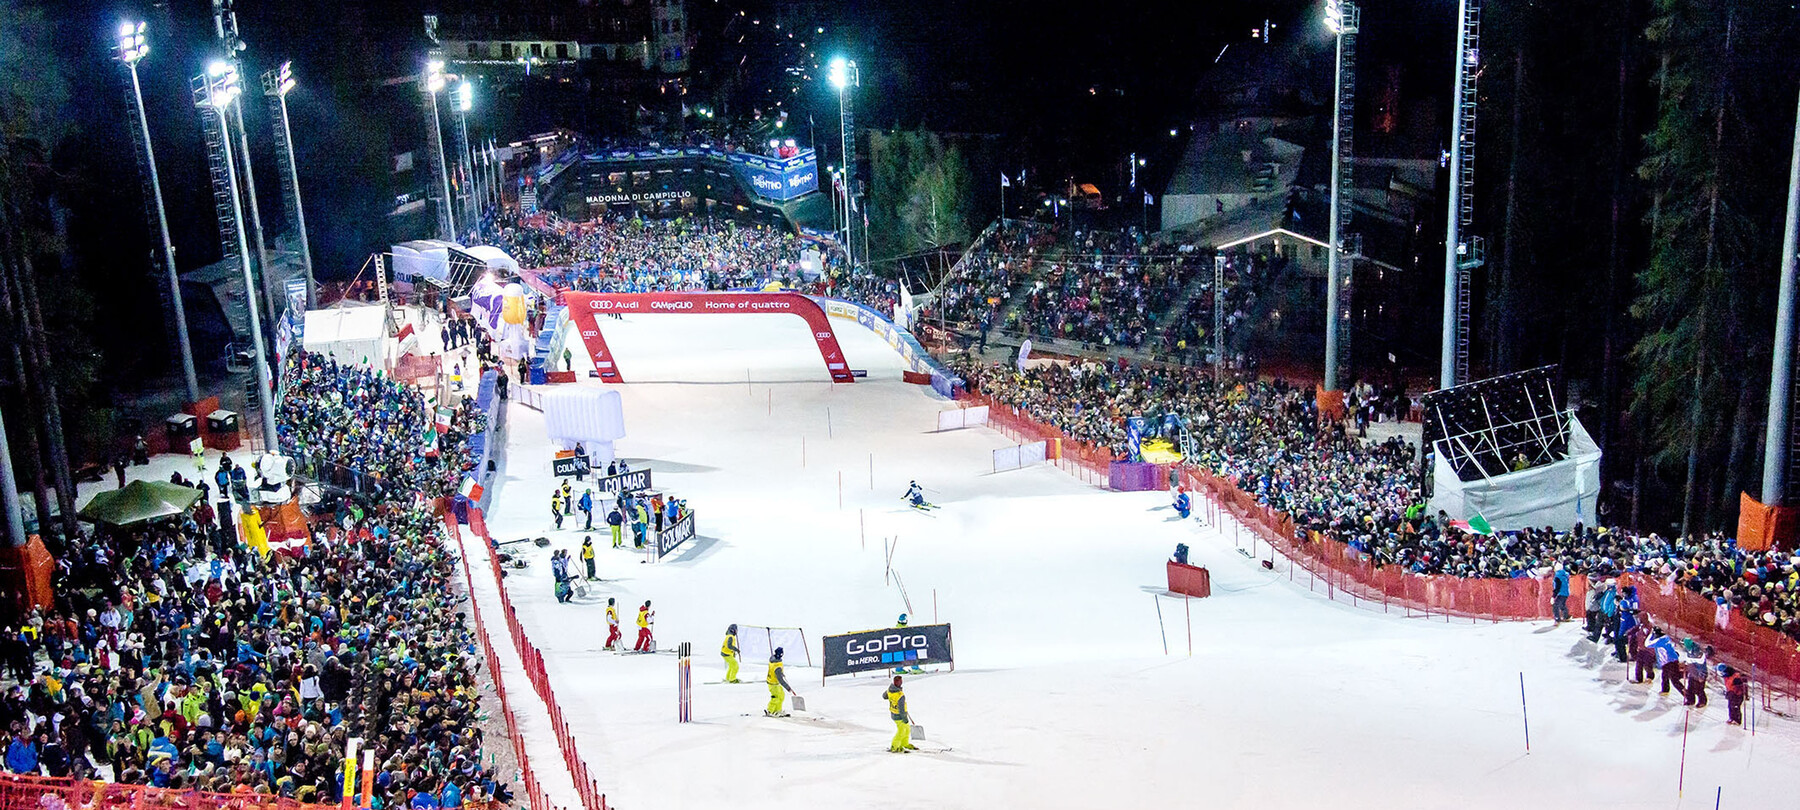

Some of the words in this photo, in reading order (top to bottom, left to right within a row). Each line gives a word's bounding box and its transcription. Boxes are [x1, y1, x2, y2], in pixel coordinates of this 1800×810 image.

[752, 175, 782, 190] TRENTINO
[586, 194, 630, 203] MADONNA
[643, 190, 691, 200] CAMPIGLIO
[614, 301, 639, 309] Audi
[705, 301, 735, 309] Home
[604, 472, 646, 493] COLMAR
[662, 517, 691, 553] COLMAR
